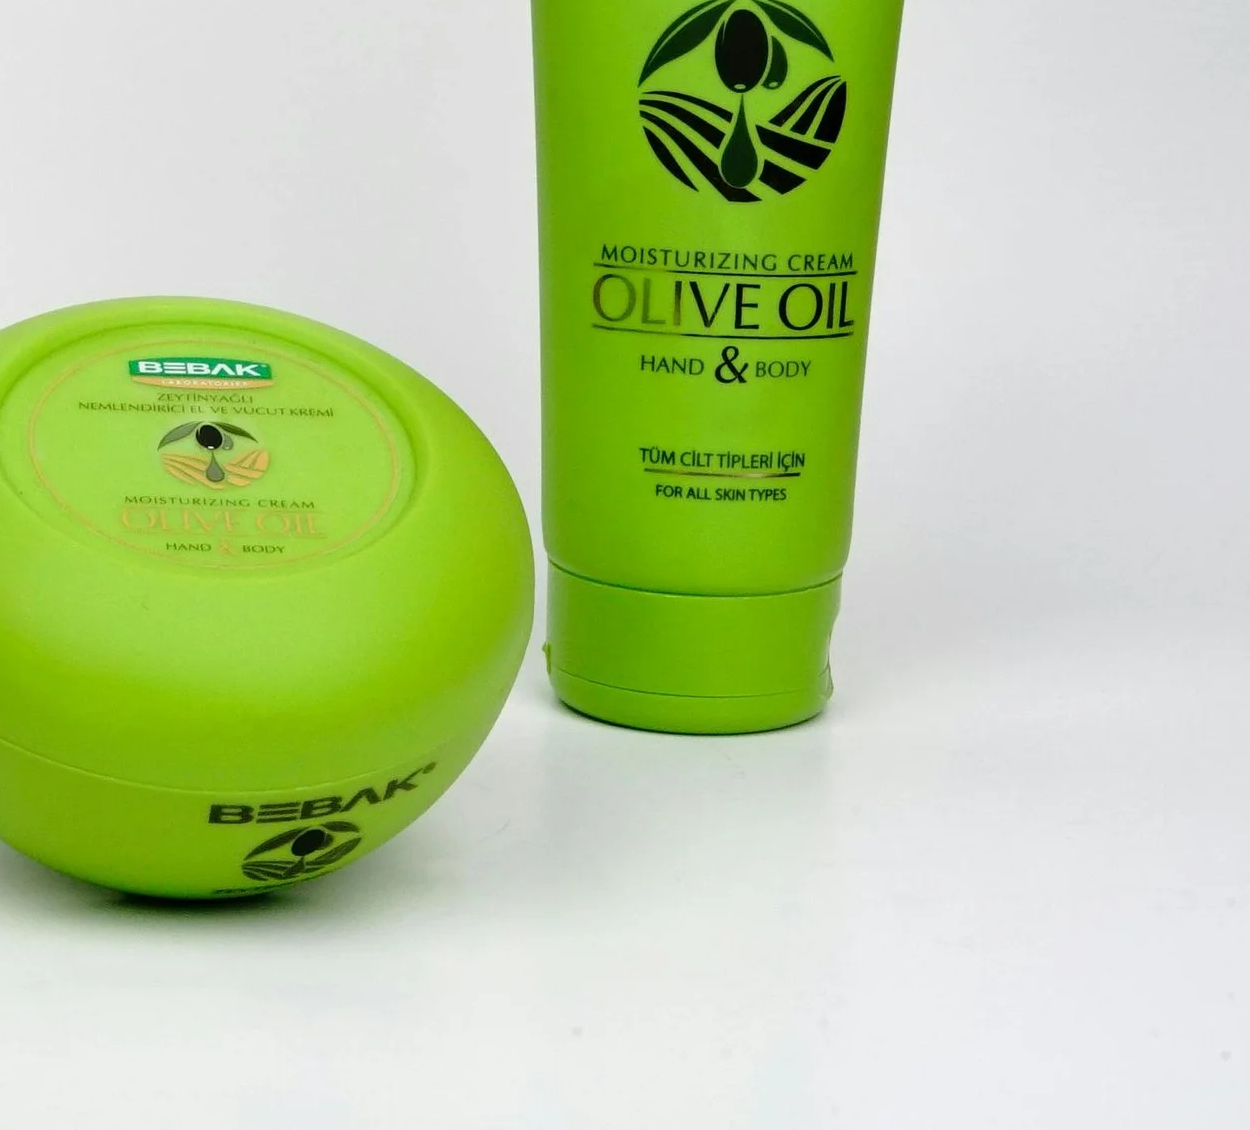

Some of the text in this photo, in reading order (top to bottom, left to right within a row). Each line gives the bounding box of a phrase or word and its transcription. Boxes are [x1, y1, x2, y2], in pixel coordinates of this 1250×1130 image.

[601, 244, 854, 271] MOISTURIZING CREAM
[593, 273, 854, 331] OLIVE OIL
[640, 346, 812, 384] HAND & BODY
[639, 446, 805, 472] TÜM CİLT TİPLERİ İÇİN
[124, 496, 315, 508] MOISTURIZING CREAM
[655, 484, 787, 502] FOR ALL SKIN TYPES
[166, 542, 212, 552] HAND
[242, 544, 286, 554] BODY
